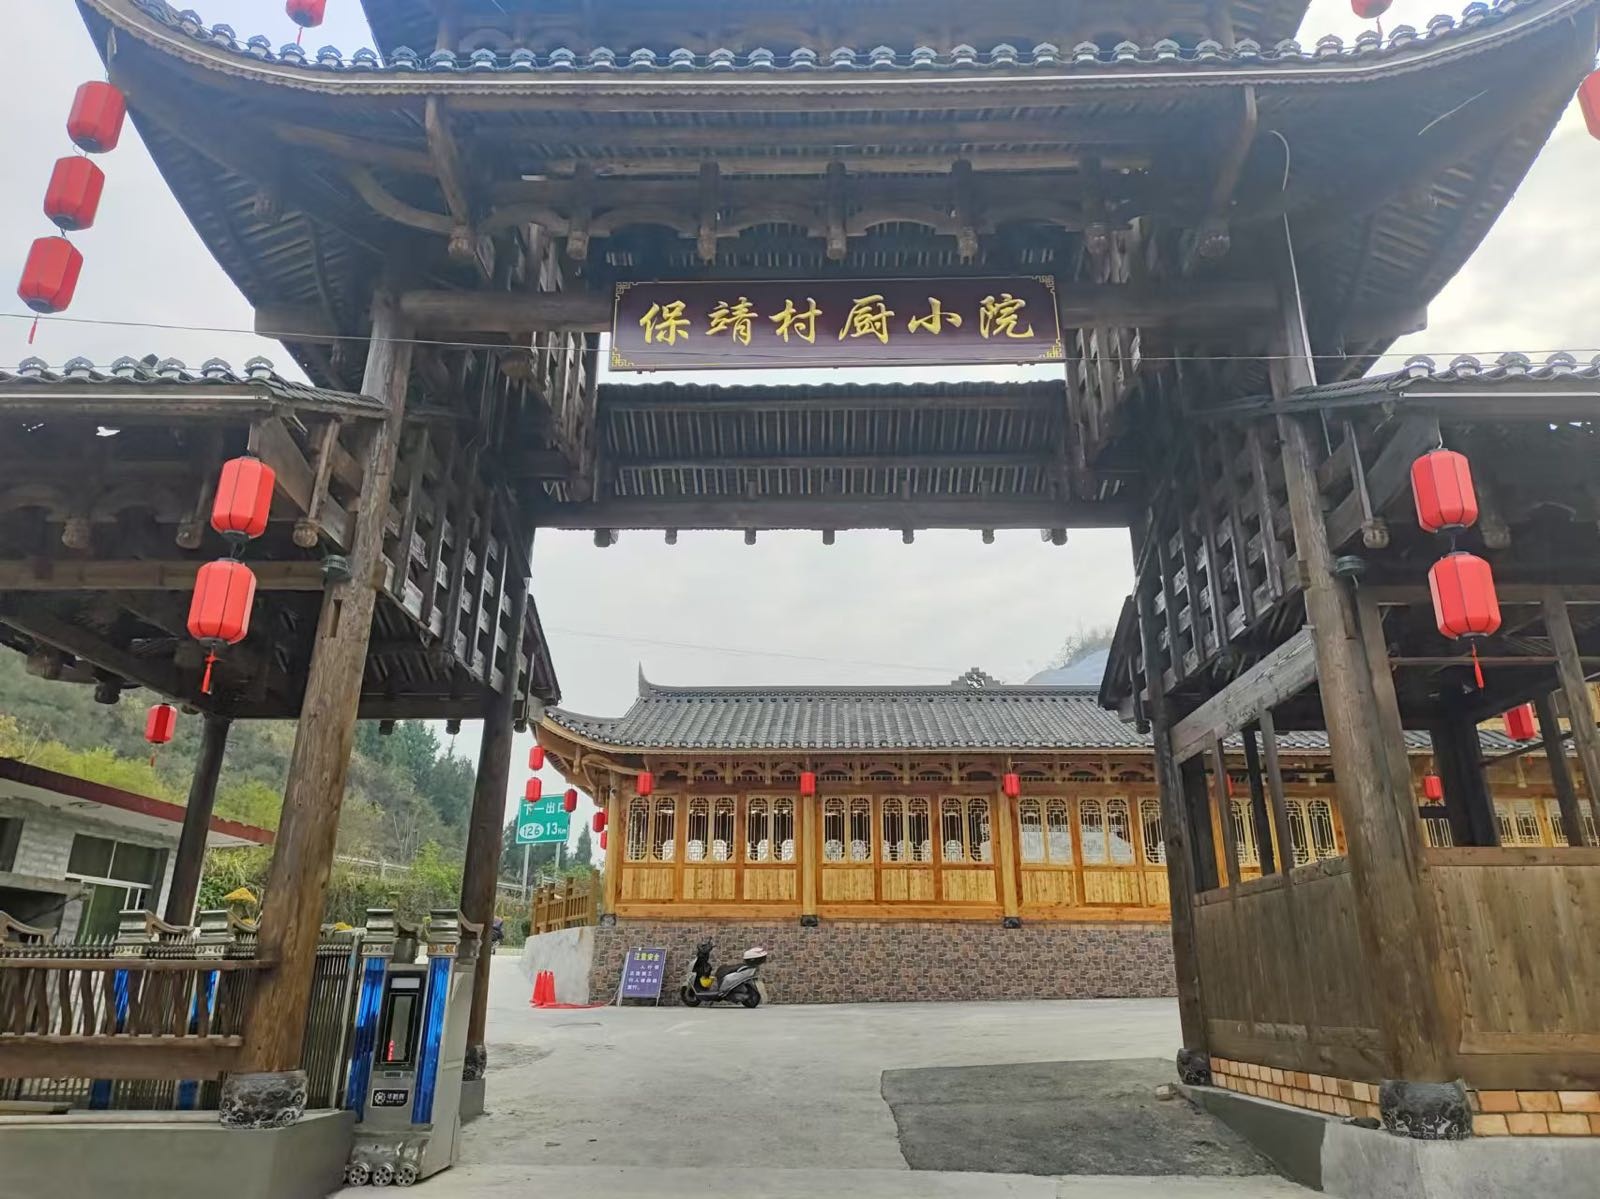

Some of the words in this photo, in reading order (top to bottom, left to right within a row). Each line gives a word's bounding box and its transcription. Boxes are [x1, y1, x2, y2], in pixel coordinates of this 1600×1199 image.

[639, 294, 1035, 346] 保靖村厨小院
[523, 825, 541, 837] 126
